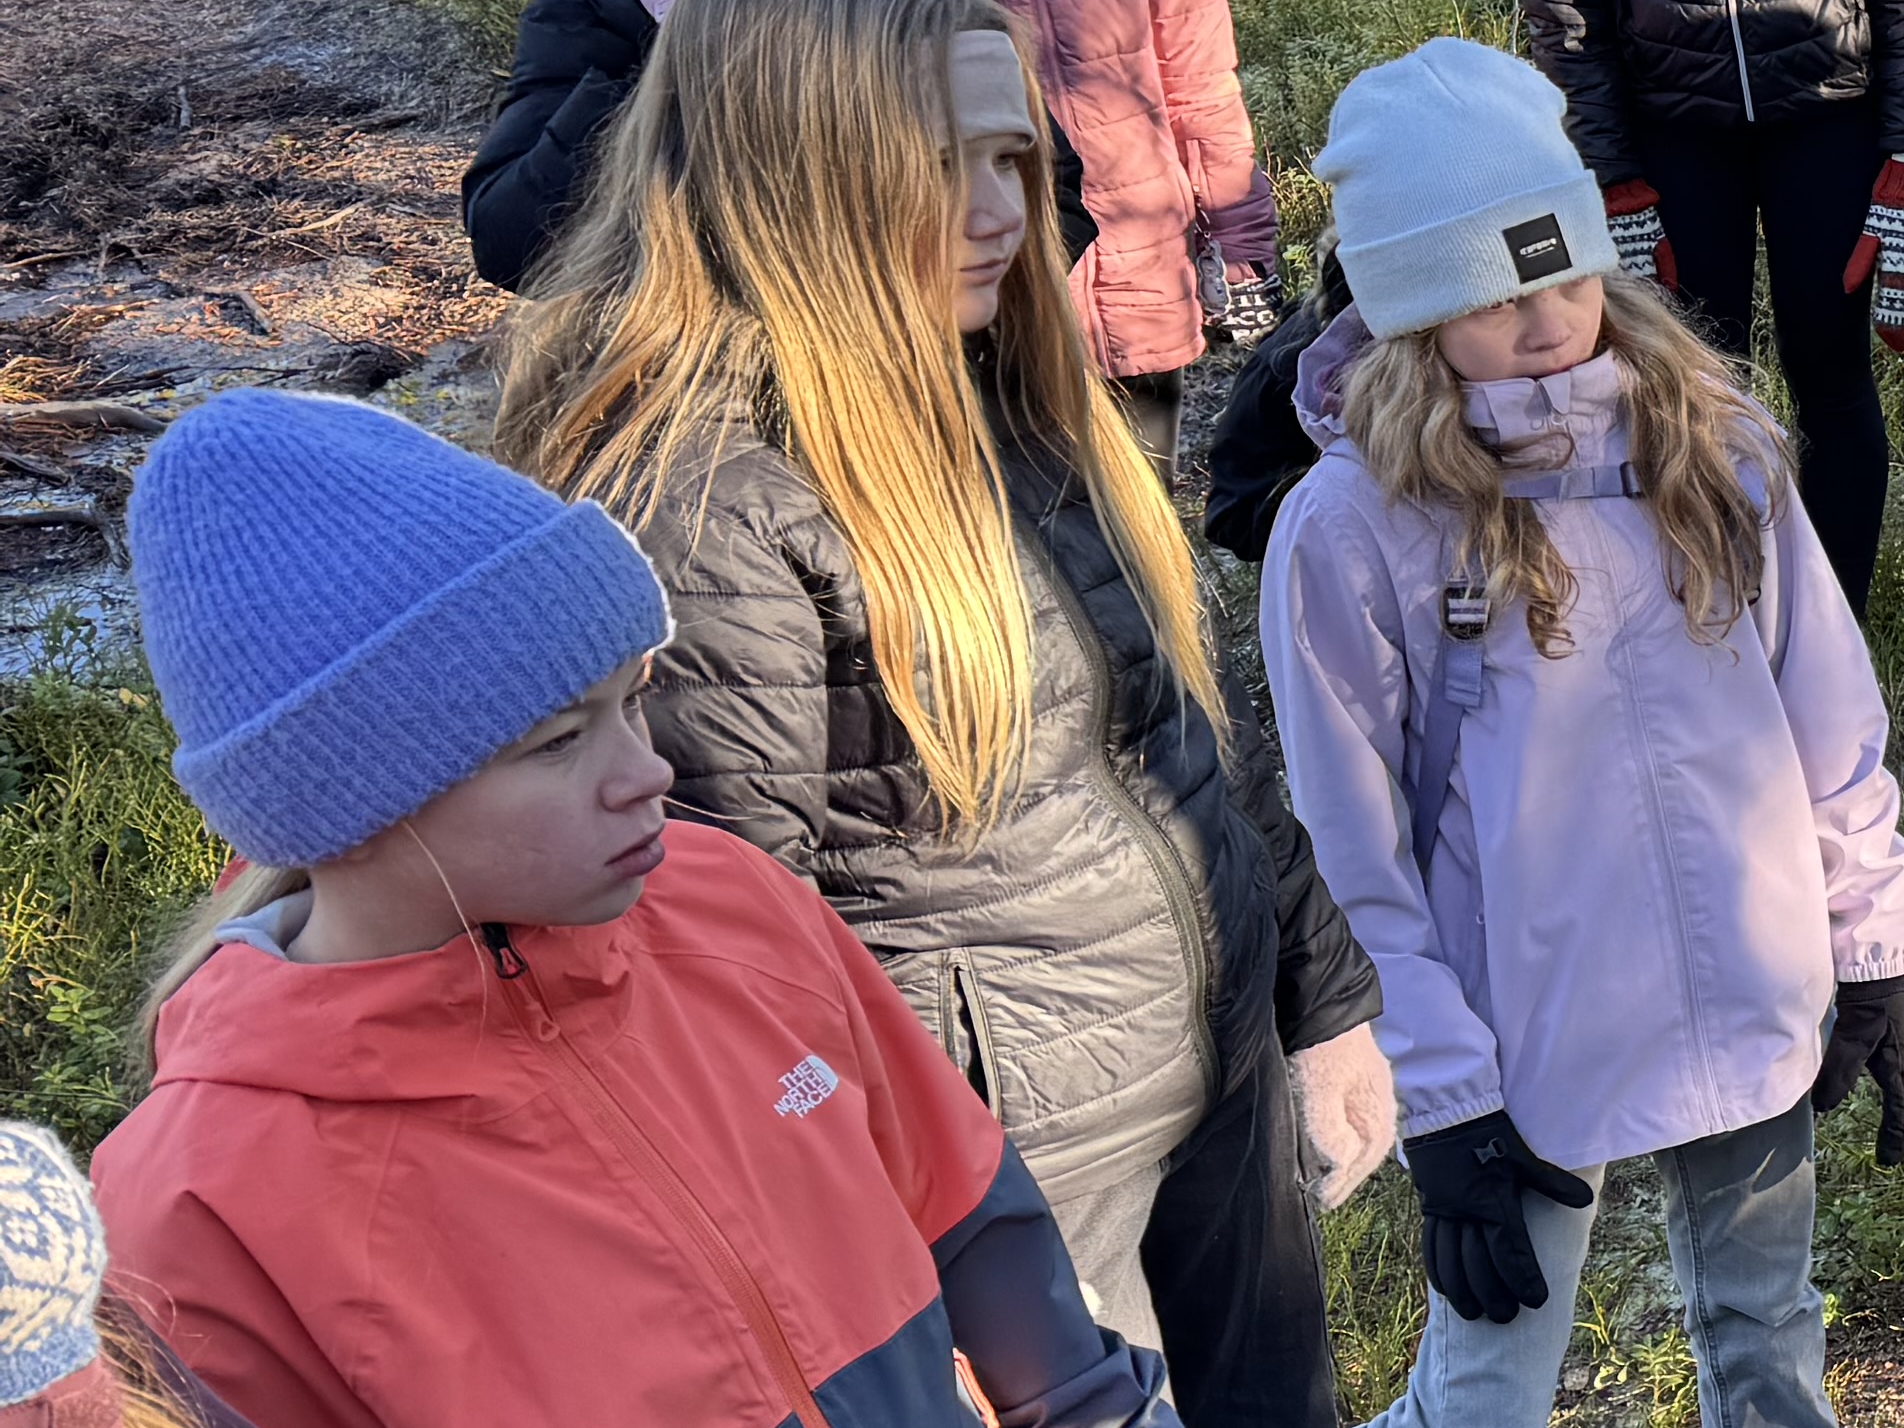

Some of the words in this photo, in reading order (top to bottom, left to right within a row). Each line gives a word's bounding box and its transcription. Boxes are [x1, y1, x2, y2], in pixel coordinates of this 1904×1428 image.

[777, 1060, 814, 1088] THE
[773, 1070, 822, 1117] NORTH
[793, 1082, 832, 1118] FACE
